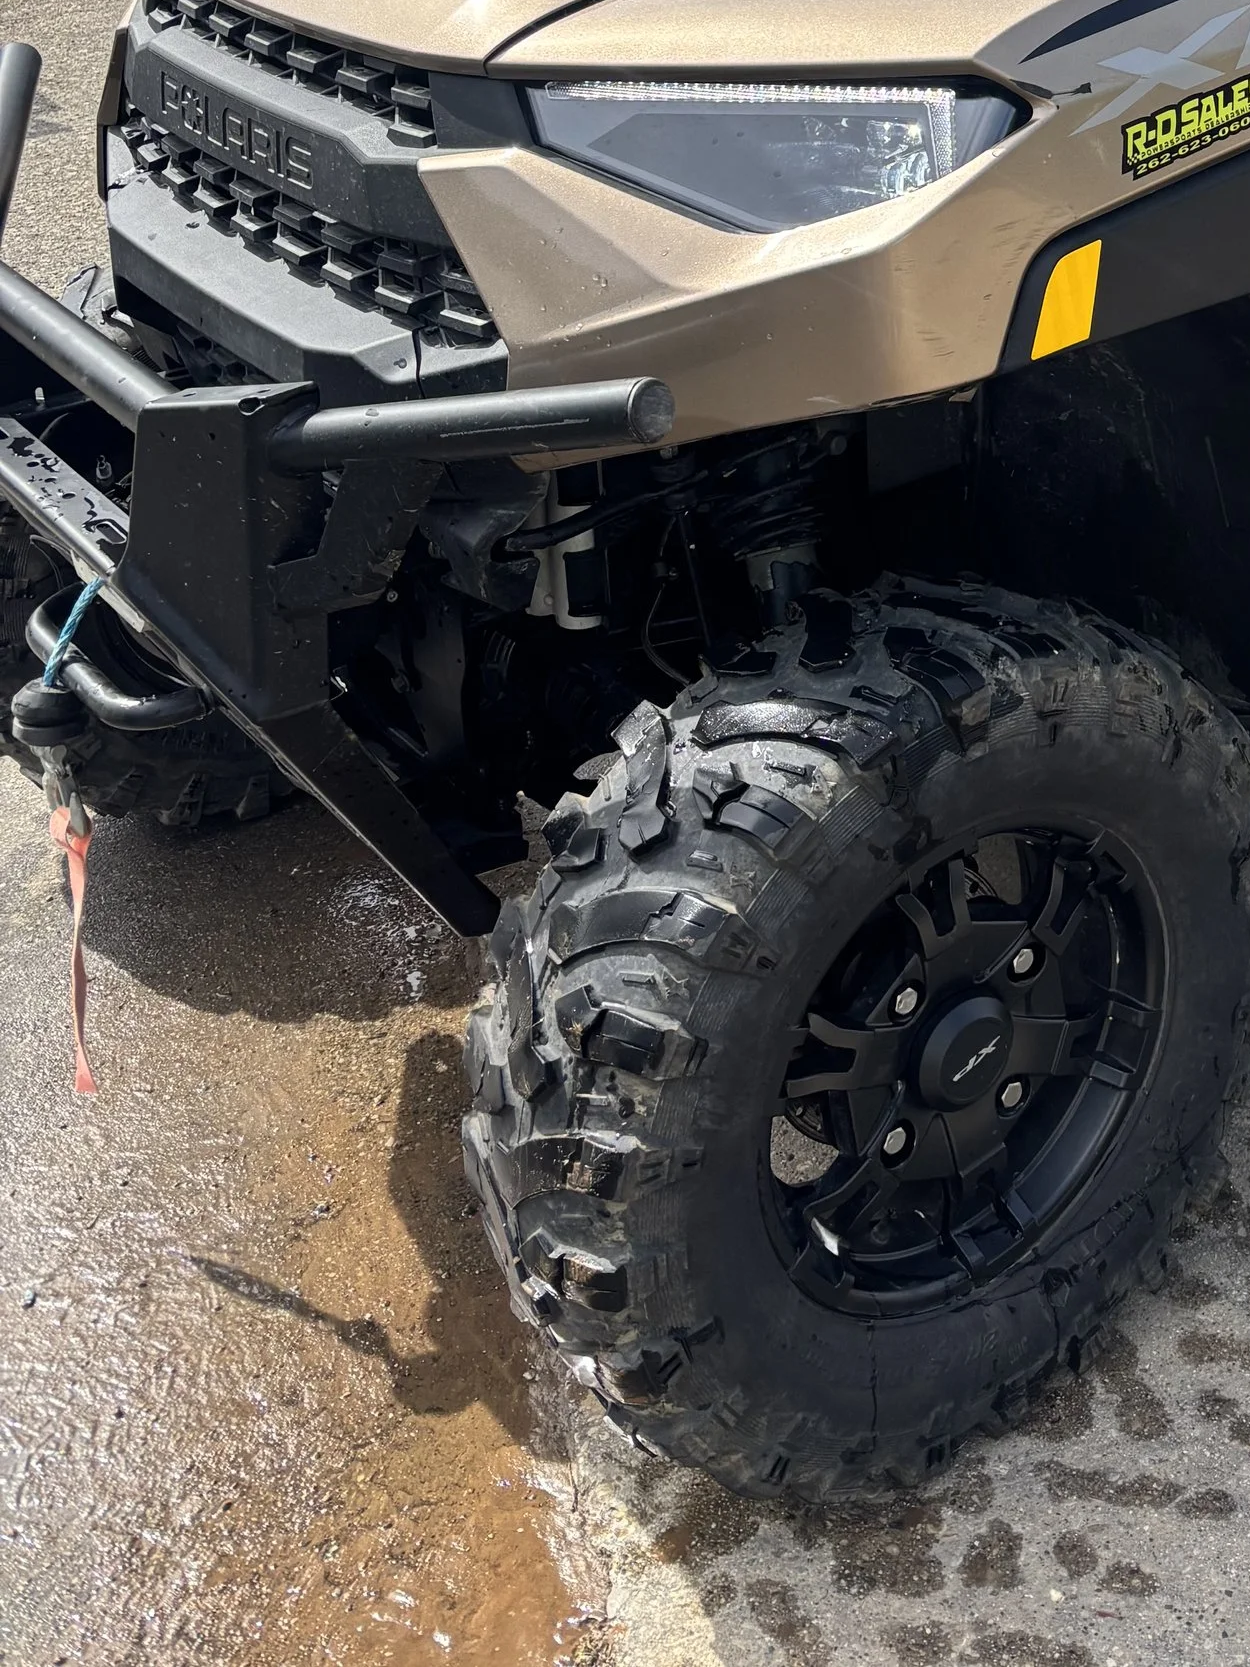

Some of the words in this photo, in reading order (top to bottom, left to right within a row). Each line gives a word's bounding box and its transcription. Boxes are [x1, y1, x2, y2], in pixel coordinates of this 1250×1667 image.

[160, 70, 314, 191] POLARIS
[1141, 127, 1203, 159] POWERSPORTS
[952, 1035, 1001, 1082] XP
